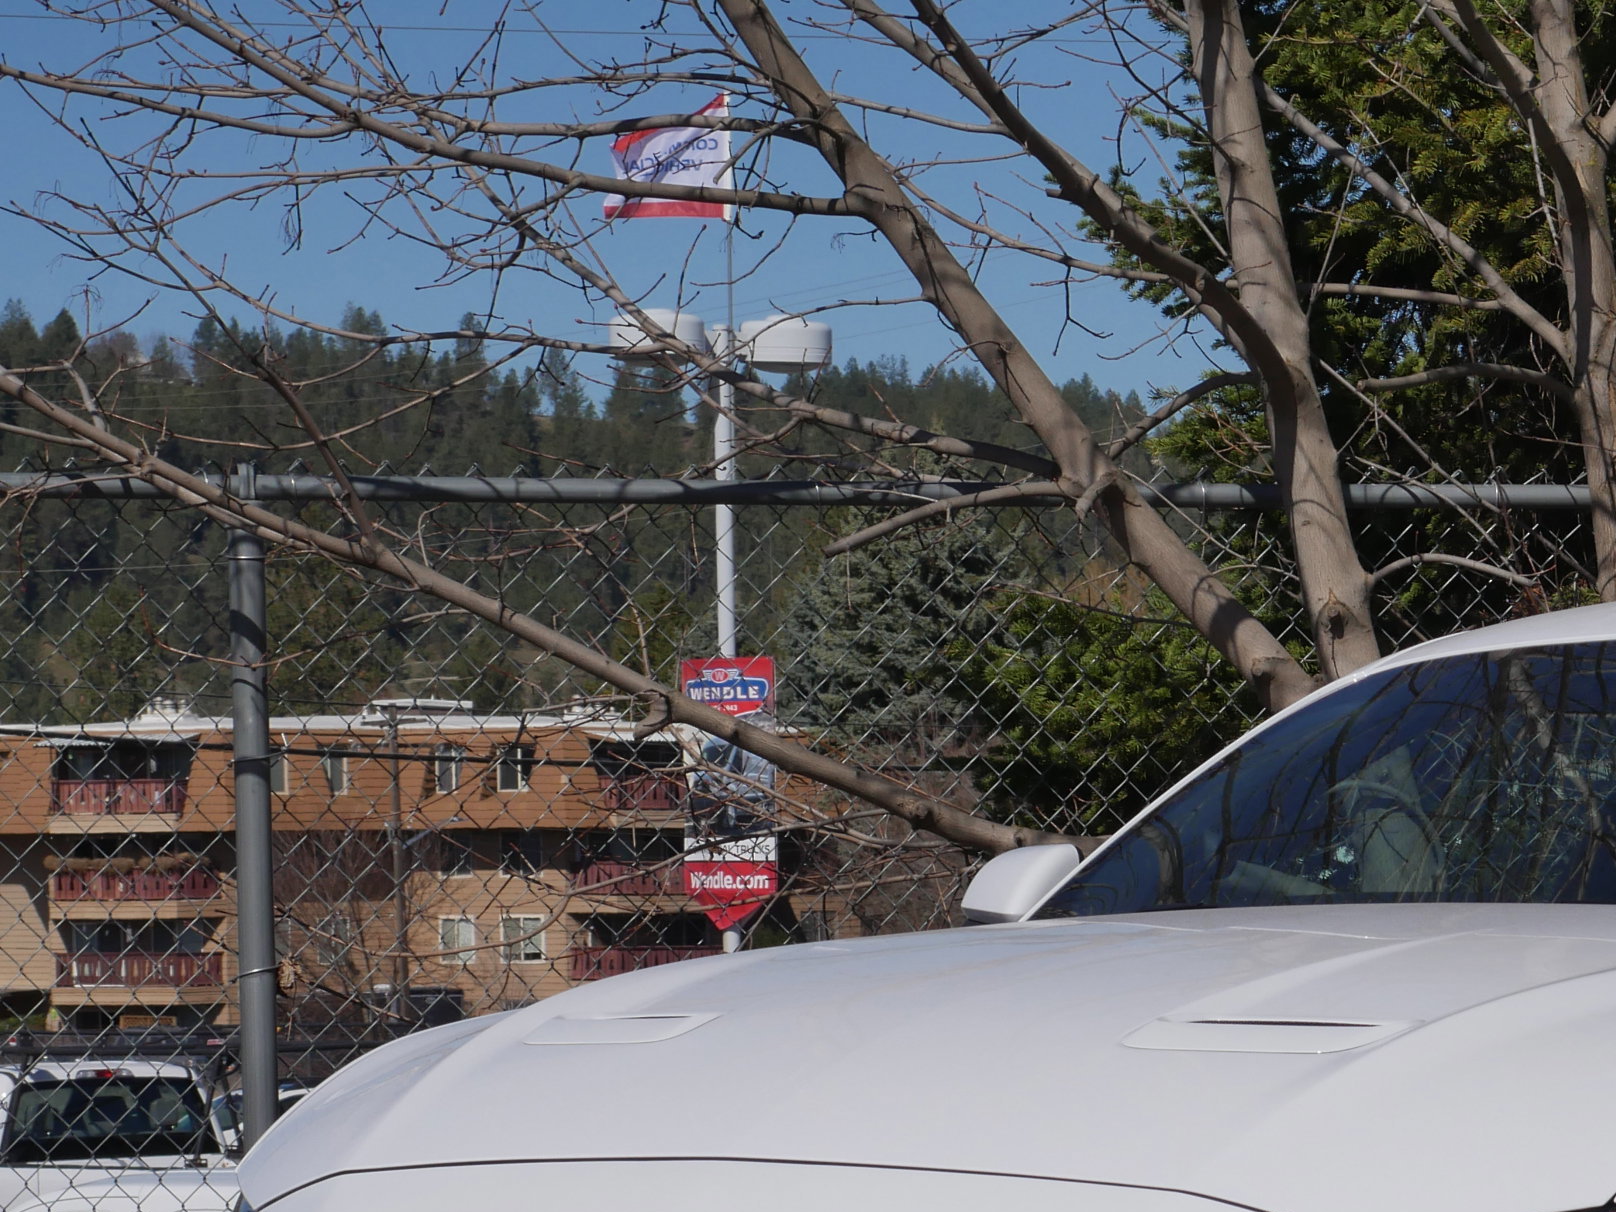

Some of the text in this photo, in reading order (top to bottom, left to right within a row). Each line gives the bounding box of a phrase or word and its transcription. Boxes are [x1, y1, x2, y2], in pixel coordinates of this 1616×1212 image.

[714, 671, 724, 681] W
[689, 686, 759, 700] WENDLE
[690, 870, 769, 889] Wendle.com
